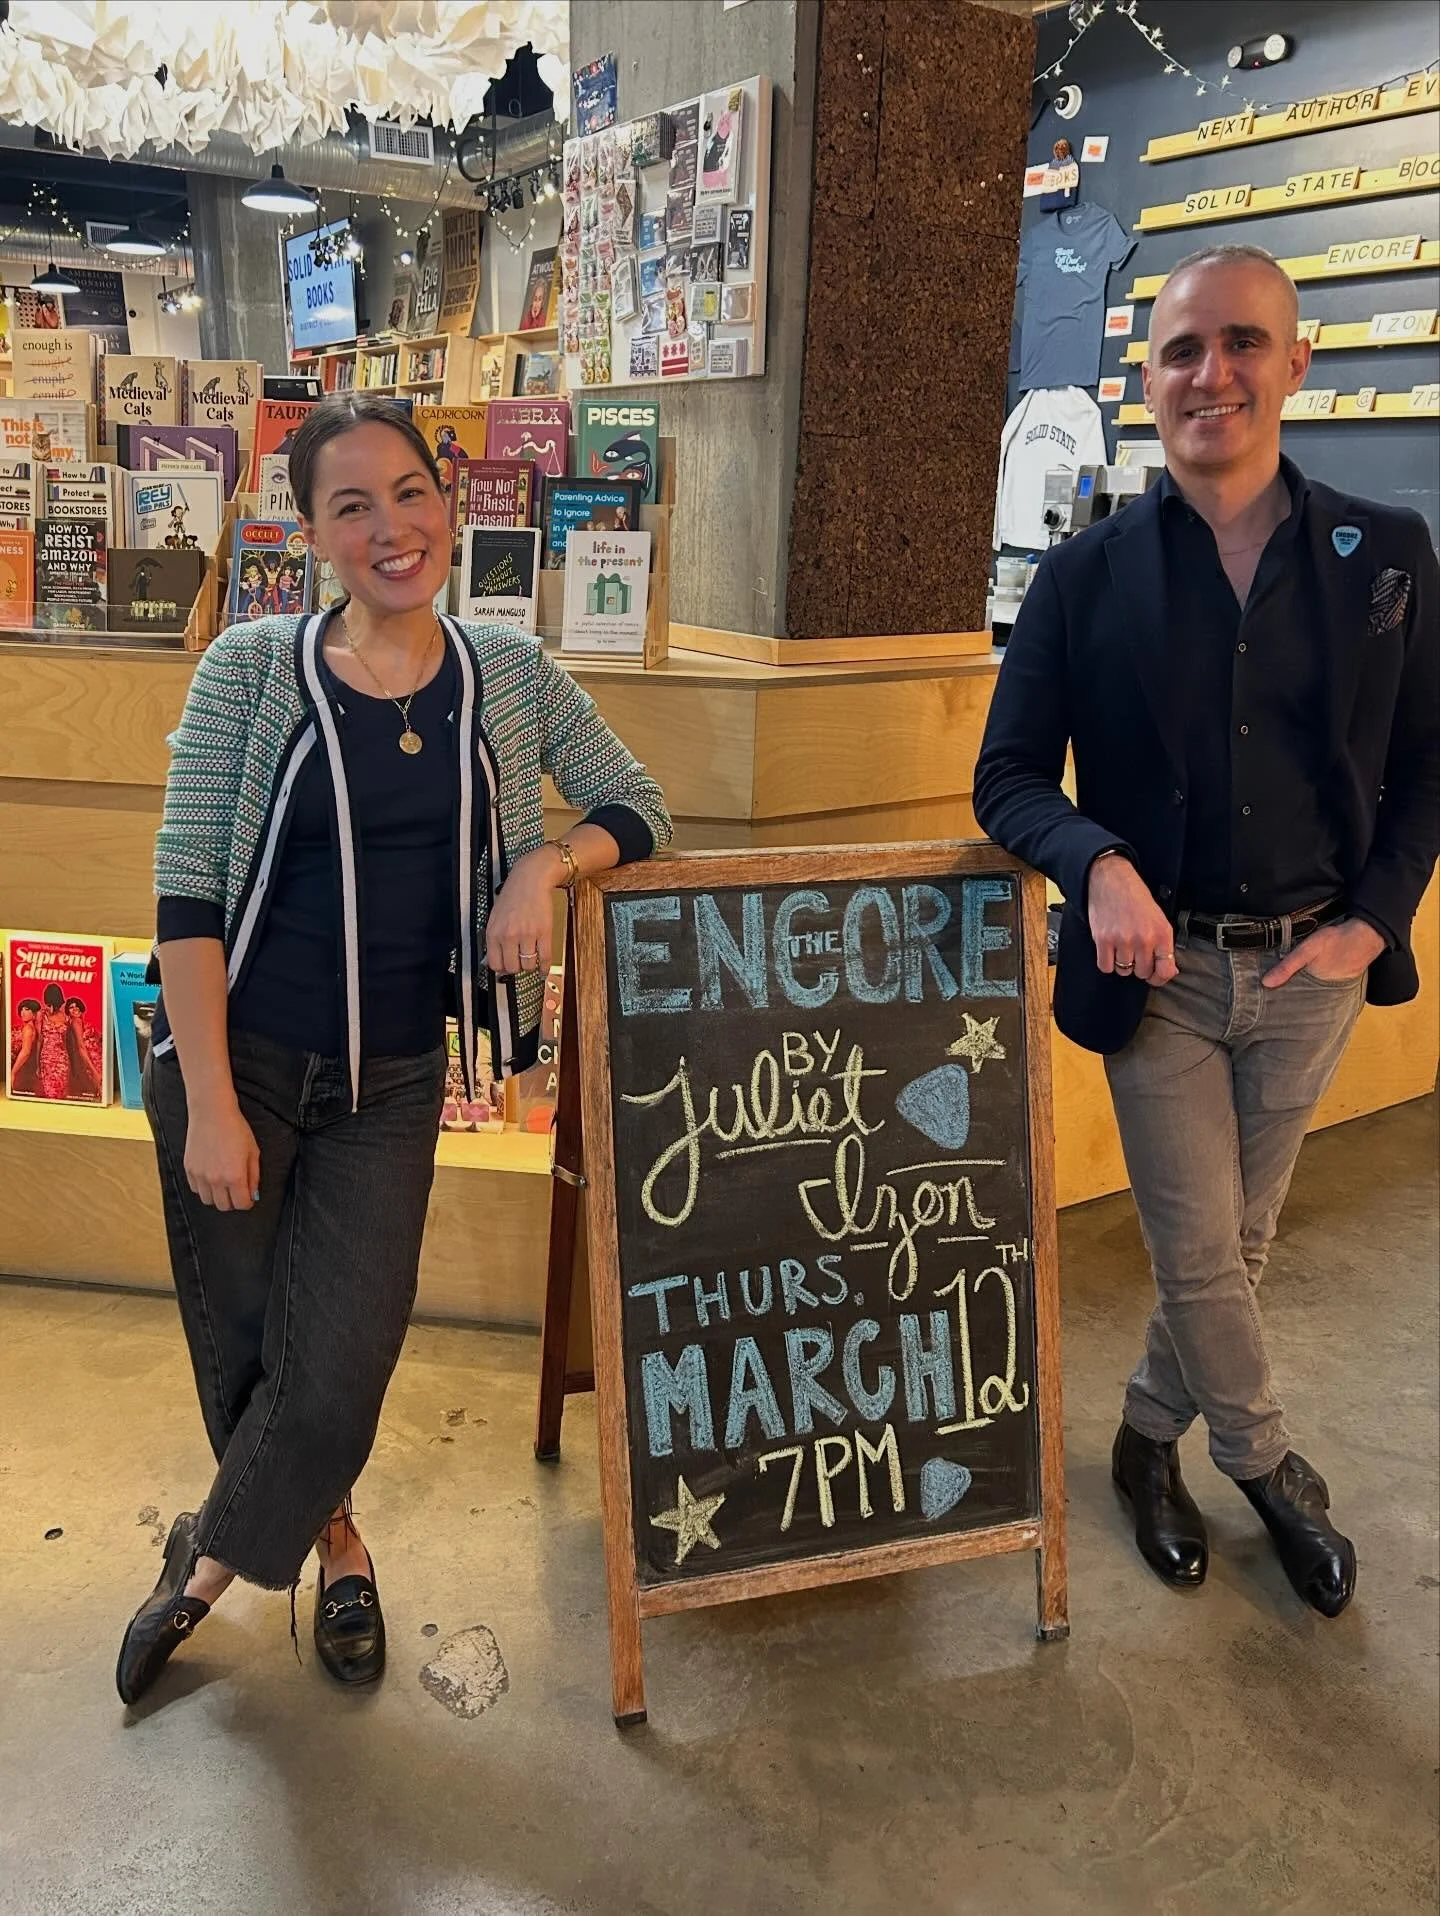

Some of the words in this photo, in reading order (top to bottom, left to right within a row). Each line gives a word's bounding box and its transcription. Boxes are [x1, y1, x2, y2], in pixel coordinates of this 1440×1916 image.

[1198, 115, 1249, 141] NEXT
[1286, 94, 1374, 122] AUTHOR
[1407, 79, 1437, 97] EV
[1185, 189, 1246, 214] SOLID
[1285, 171, 1354, 198] STATE
[1328, 239, 1416, 265] ENCORE
[288, 253, 313, 282] SOLID
[307, 281, 335, 309] BOOKS
[1375, 315, 1432, 333] IZON
[22, 338, 61, 354] enough
[64, 341, 73, 351] is
[109, 385, 167, 402] Medieval
[192, 391, 249, 406] Medieval
[1356, 390, 1372, 408] @
[123, 402, 152, 417] Cats
[206, 407, 234, 422] Cats
[421, 409, 486, 422] CAPRICORN
[586, 407, 656, 427] PISCES
[2, 417, 30, 432] This
[32, 419, 45, 432] is
[5, 434, 31, 445] not
[1025, 424, 1049, 445] SOLID
[1050, 425, 1077, 456] STATE
[51, 447, 74, 461] my
[62, 471, 78, 479] How
[62, 488, 90, 497] Protect
[139, 486, 171, 506] REY
[554, 492, 593, 504] Parenting
[594, 493, 625, 503] Advice
[48, 505, 107, 516] BOOKSTORES
[553, 508, 562, 516] to
[563, 508, 591, 519] Ignore
[48, 524, 73, 534] HOW
[74, 525, 89, 535] TO
[245, 530, 280, 539] OCCULT
[552, 523, 560, 532] in
[562, 523, 575, 531] Art
[44, 534, 94, 549] RESIST
[592, 541, 612, 554] life
[614, 545, 626, 554] in
[41, 548, 98, 562] amazon
[577, 555, 597, 567] the
[600, 556, 644, 569] present
[47, 562, 67, 571] AND
[69, 563, 92, 573] WHY
[478, 551, 513, 589] QUESTIONS
[484, 567, 513, 591] WITHOUT
[488, 574, 521, 595] ANSWERS
[473, 606, 496, 617] SARAH
[496, 607, 526, 618] MANGUSO
[610, 878, 1020, 1017] ENCORE
[788, 930, 842, 960] THE
[15, 946, 98, 968] Supreme
[15, 962, 97, 984] Glamour
[782, 1028, 841, 1076] BY
[620, 1044, 888, 1229] Juliet
[799, 1133, 998, 1301] Izon
[628, 1253, 865, 1336] THURS.
[640, 1308, 957, 1458] MARCH
[994, 1237, 1030, 1266] TH
[756, 1422, 906, 1532] 7PM
